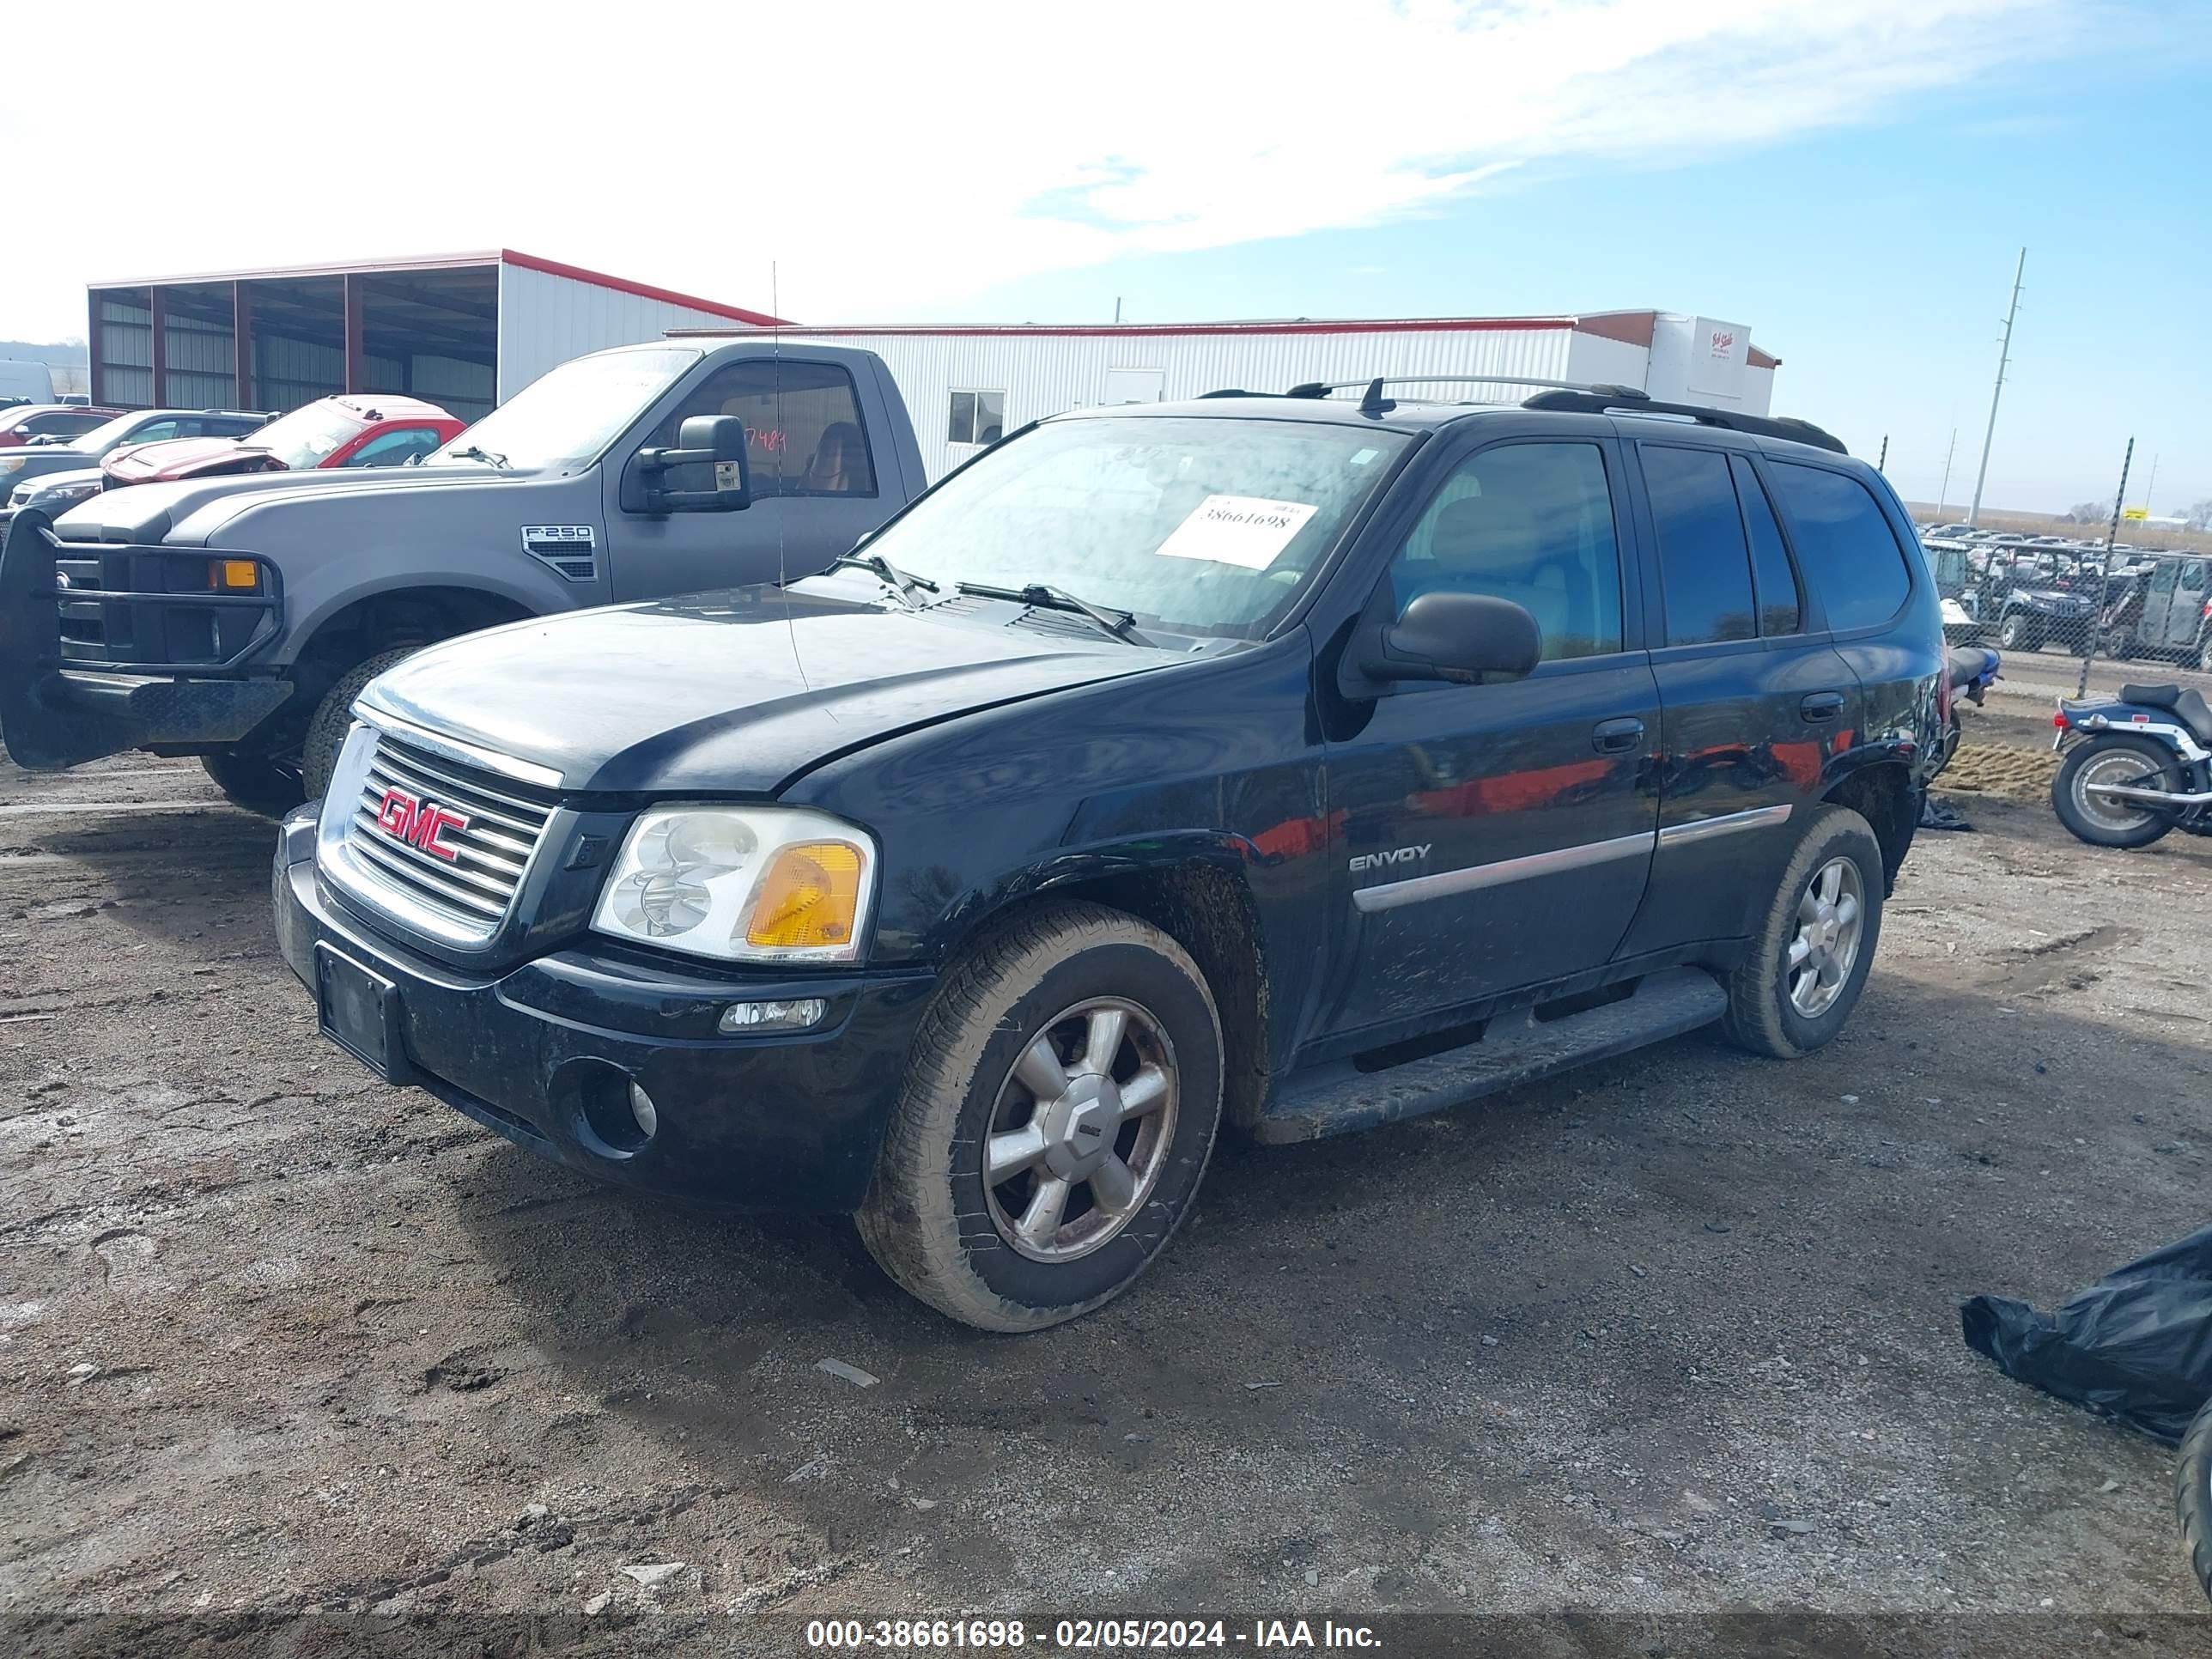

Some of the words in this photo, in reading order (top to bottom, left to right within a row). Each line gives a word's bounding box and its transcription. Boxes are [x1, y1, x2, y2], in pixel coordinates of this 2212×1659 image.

[1200, 508, 1291, 530] 38661698
[378, 785, 470, 863] GMC
[1348, 843, 1432, 872] ENVOY
